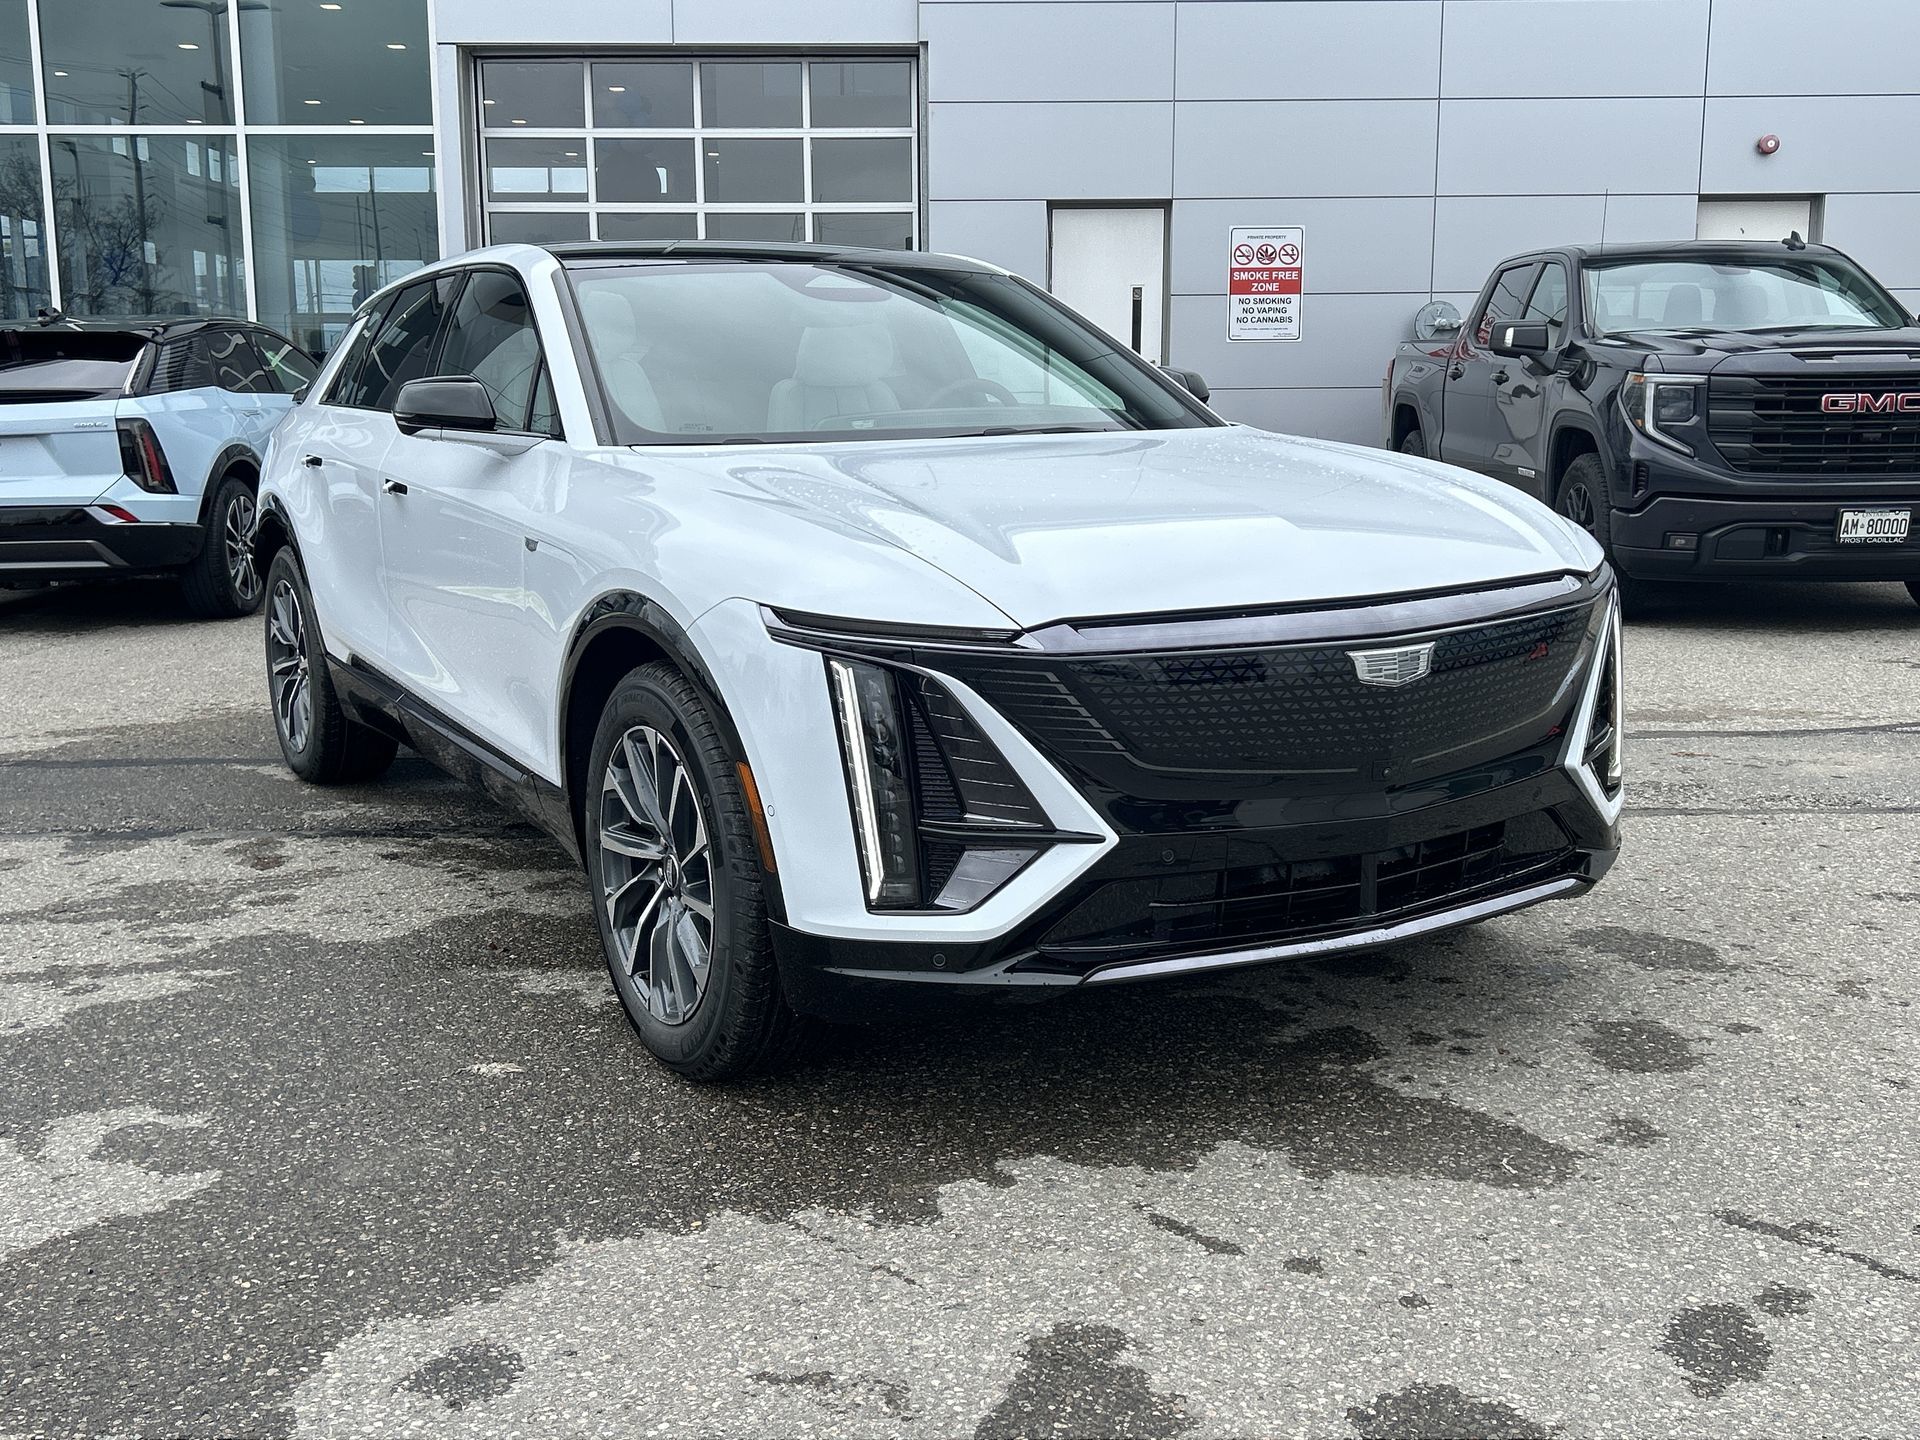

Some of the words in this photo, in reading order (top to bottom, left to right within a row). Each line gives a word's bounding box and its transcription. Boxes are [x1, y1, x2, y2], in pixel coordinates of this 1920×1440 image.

[1233, 271, 1270, 280] SMOKE
[1272, 271, 1298, 280] FREE
[1251, 282, 1280, 292] ZONE
[1252, 297, 1292, 305] SMOKING
[1821, 393, 1920, 413] GMC
